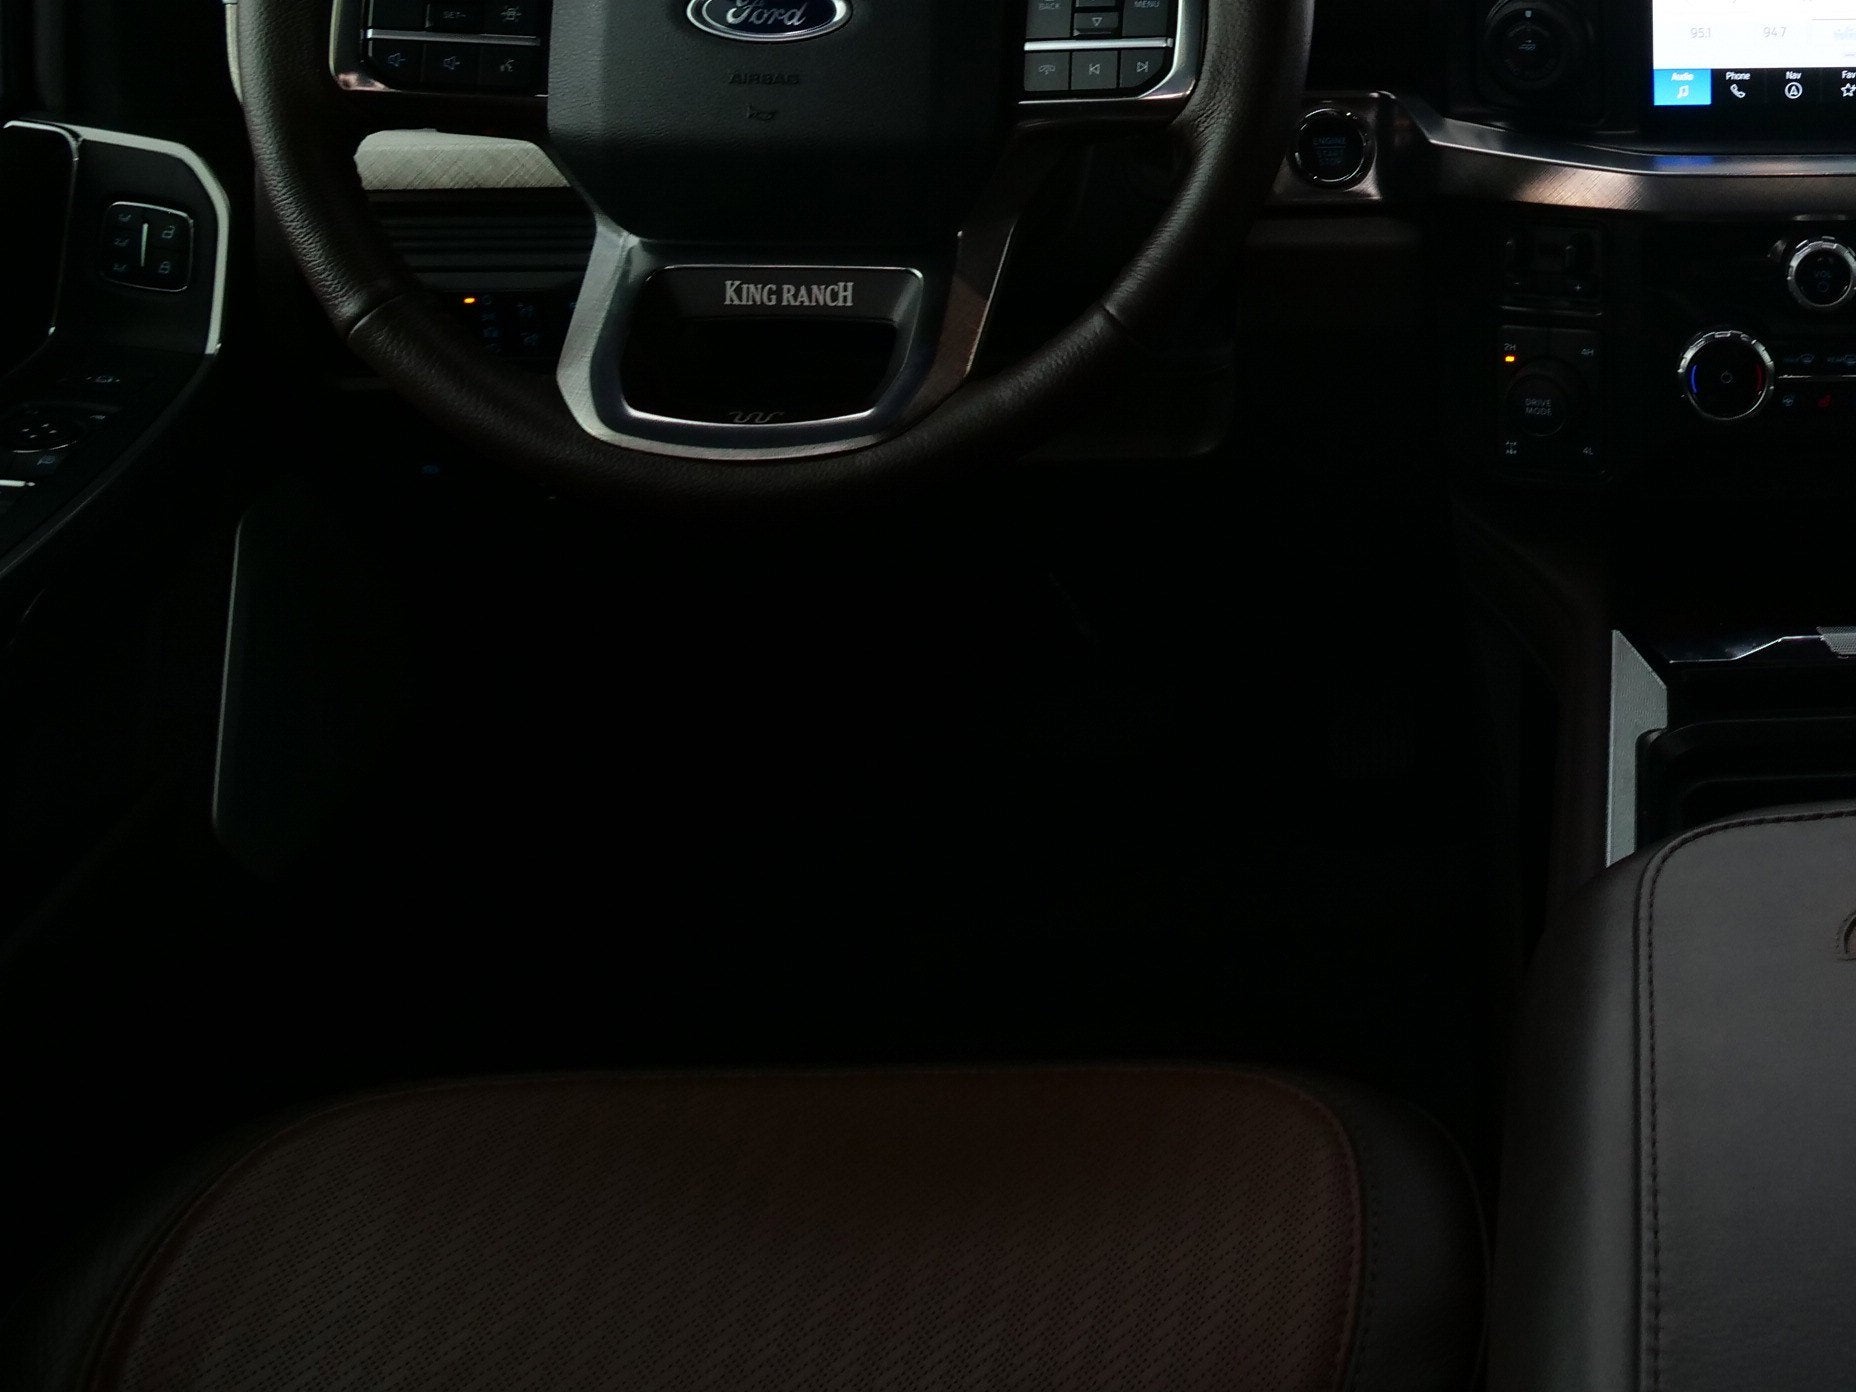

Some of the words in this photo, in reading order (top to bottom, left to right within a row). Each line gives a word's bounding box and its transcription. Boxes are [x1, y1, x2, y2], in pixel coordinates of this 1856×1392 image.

[1690, 26, 1711, 39] 95.1
[1671, 72, 1694, 81] Audio
[1726, 71, 1750, 80] Phone
[1786, 71, 1802, 80] Nav
[1842, 71, 1856, 79] Fav
[724, 280, 777, 306] KING
[781, 282, 854, 307] RANCH
